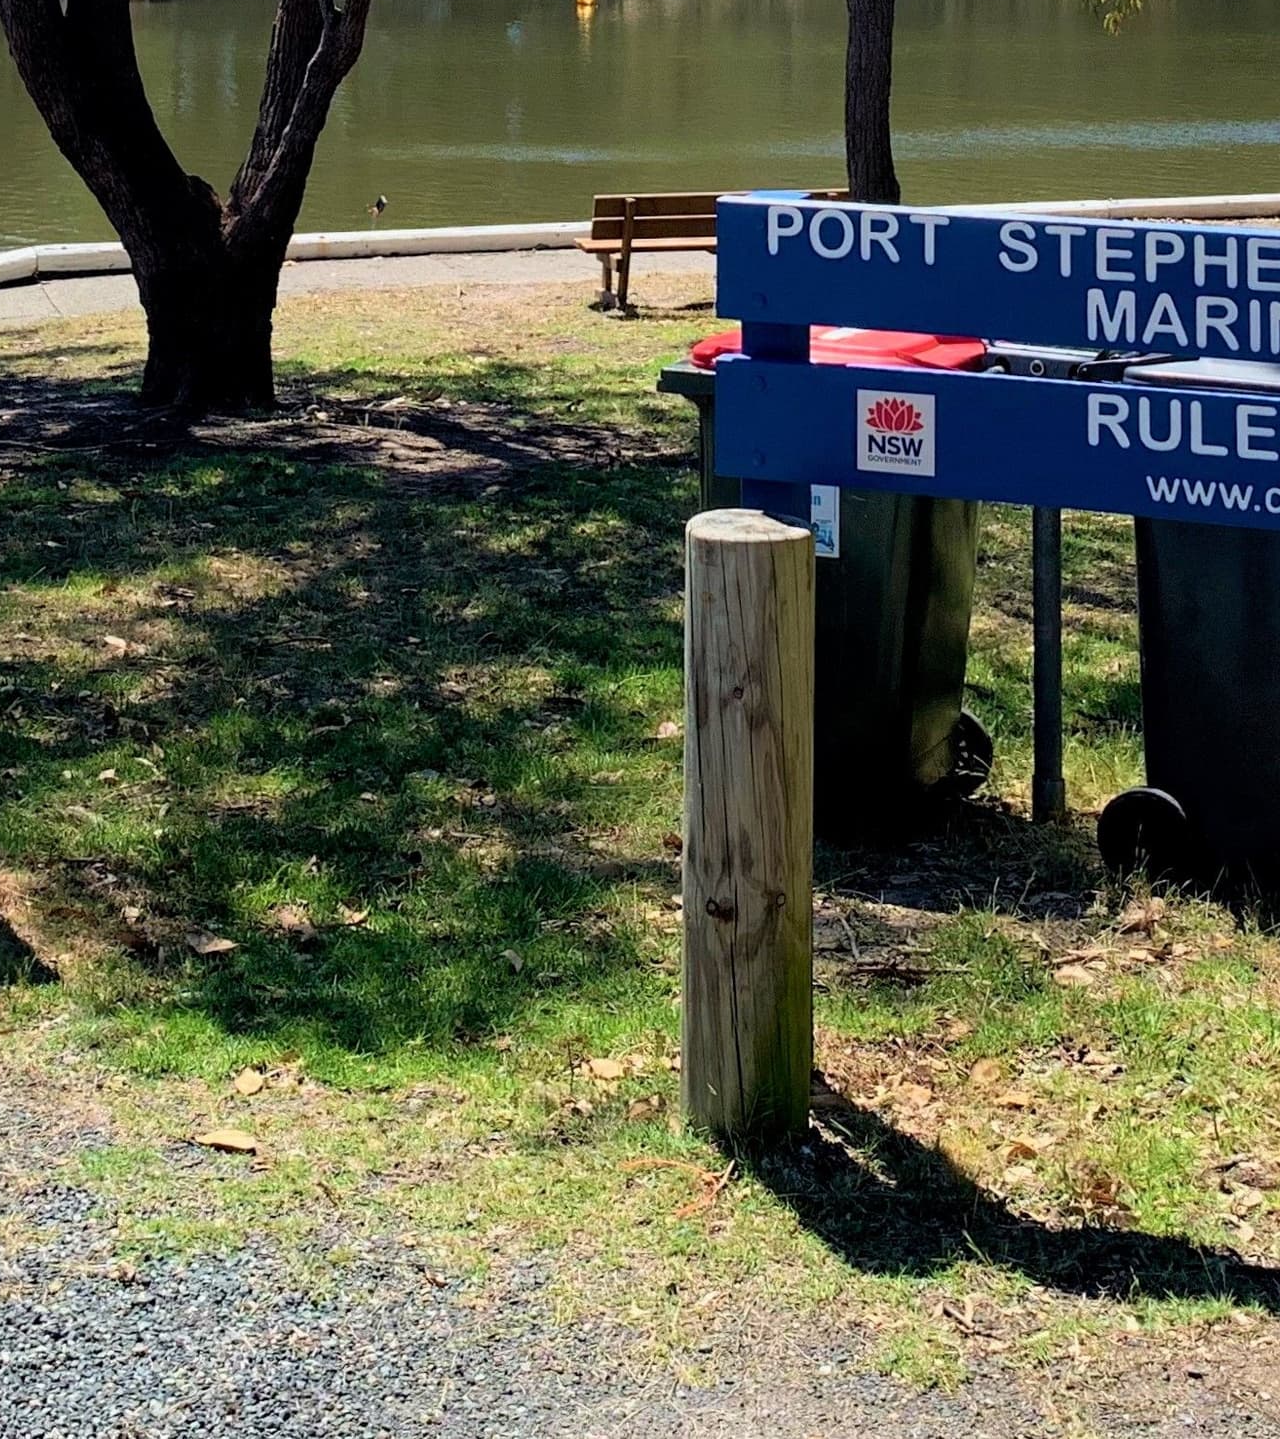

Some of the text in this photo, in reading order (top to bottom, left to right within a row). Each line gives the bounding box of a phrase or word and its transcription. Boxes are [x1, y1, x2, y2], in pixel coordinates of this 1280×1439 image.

[766, 206, 950, 266] PORT
[867, 434, 924, 457] NSW
[867, 455, 923, 466] GOVERNMENT
